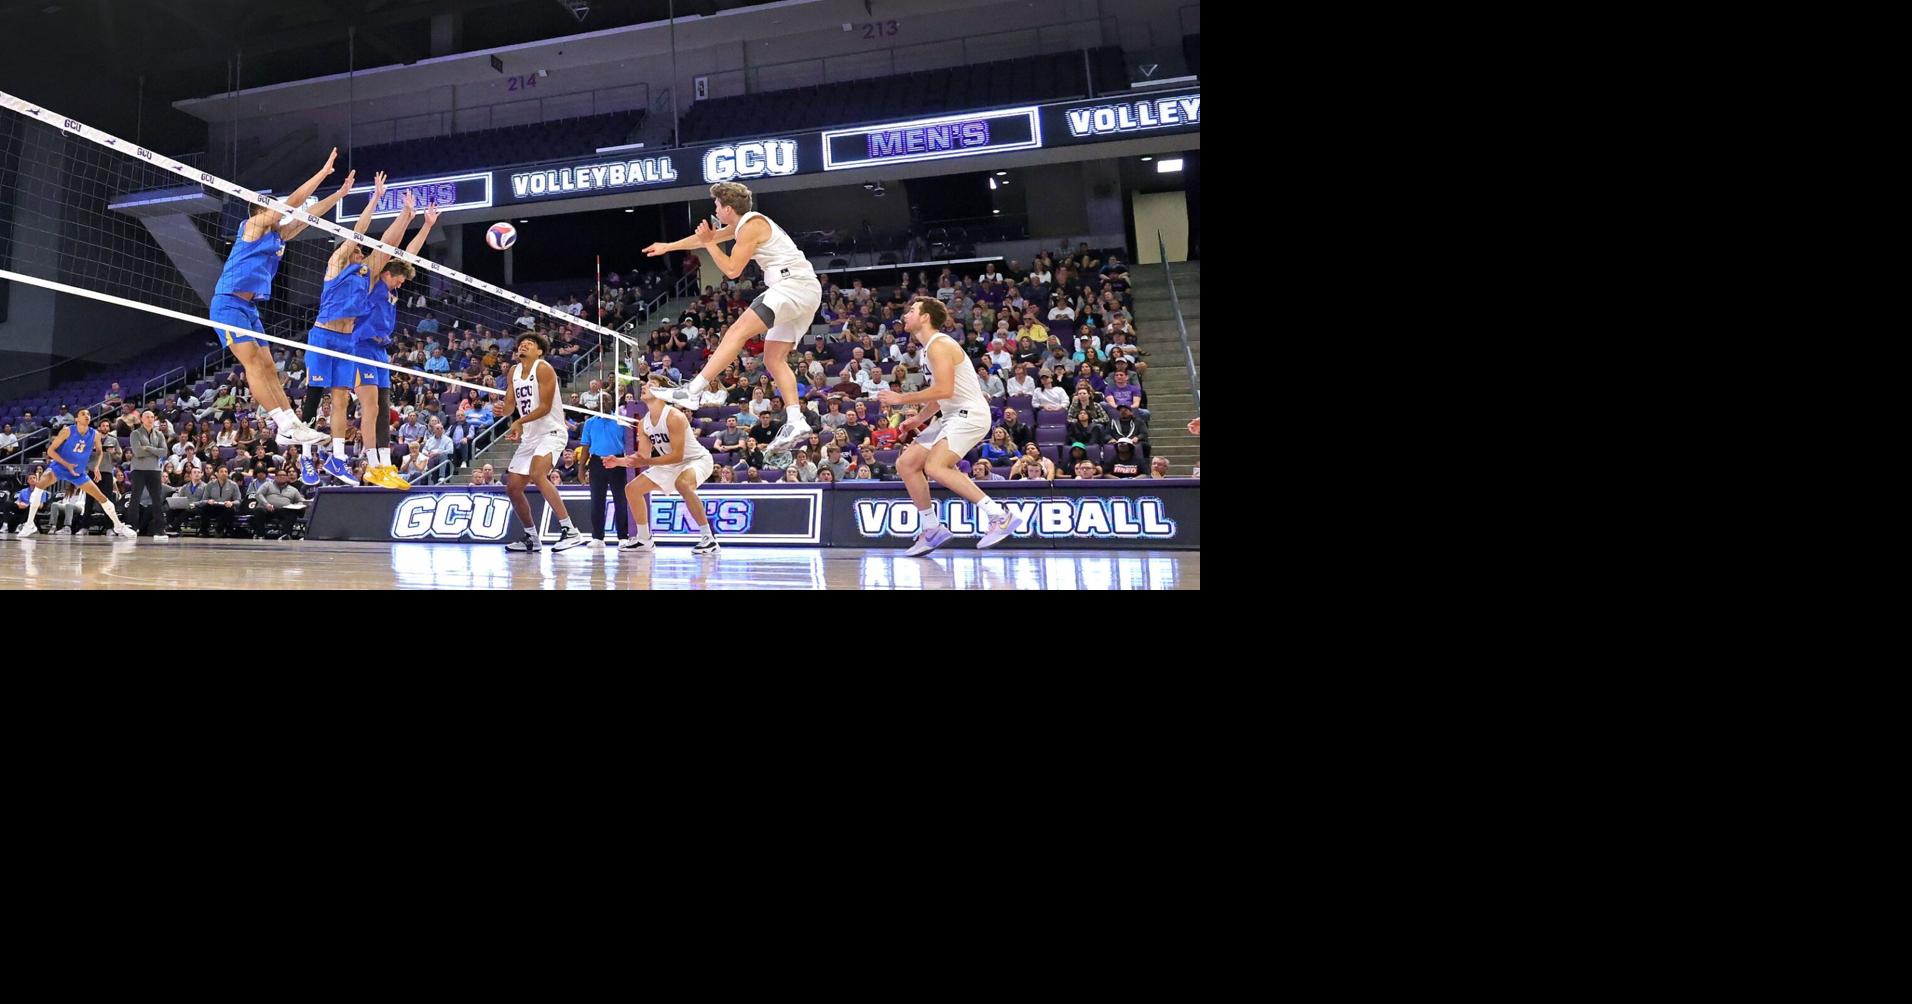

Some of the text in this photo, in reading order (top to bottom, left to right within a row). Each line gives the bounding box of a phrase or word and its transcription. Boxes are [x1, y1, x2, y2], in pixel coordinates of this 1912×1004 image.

[863, 20, 898, 39] 213
[508, 74, 536, 91] 214
[512, 157, 677, 198] VOLLEYBALL
[704, 140, 798, 182] GCU
[868, 120, 989, 157] MEN'S
[1066, 95, 1200, 136] VOLLEY
[64, 119, 82, 132] GCU
[137, 148, 152, 160] GCU
[201, 173, 215, 184] GCU
[257, 195, 270, 205] GCU
[516, 385, 532, 398] GCU
[73, 443, 86, 453] 13
[650, 433, 670, 445] GCU
[392, 493, 1175, 539] GCU EN'S VOLYBALL
